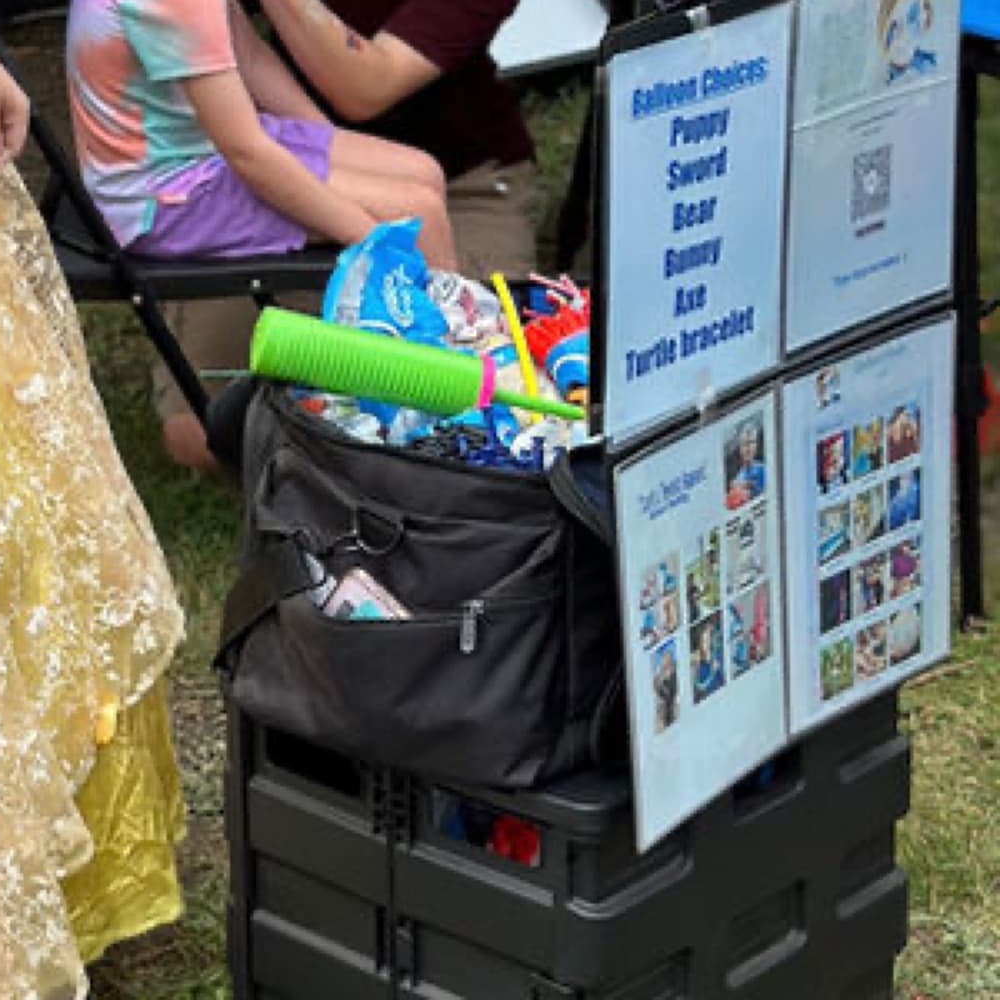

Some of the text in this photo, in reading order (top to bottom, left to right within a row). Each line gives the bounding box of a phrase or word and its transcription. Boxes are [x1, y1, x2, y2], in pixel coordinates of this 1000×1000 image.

[633, 77, 698, 118] Balloon
[672, 108, 730, 147] Puppy
[667, 147, 727, 190] Sword
[673, 197, 717, 232] Bear
[665, 237, 722, 280] Bunny
[674, 284, 707, 318] Axe
[626, 305, 755, 381] Turtle bracelet
